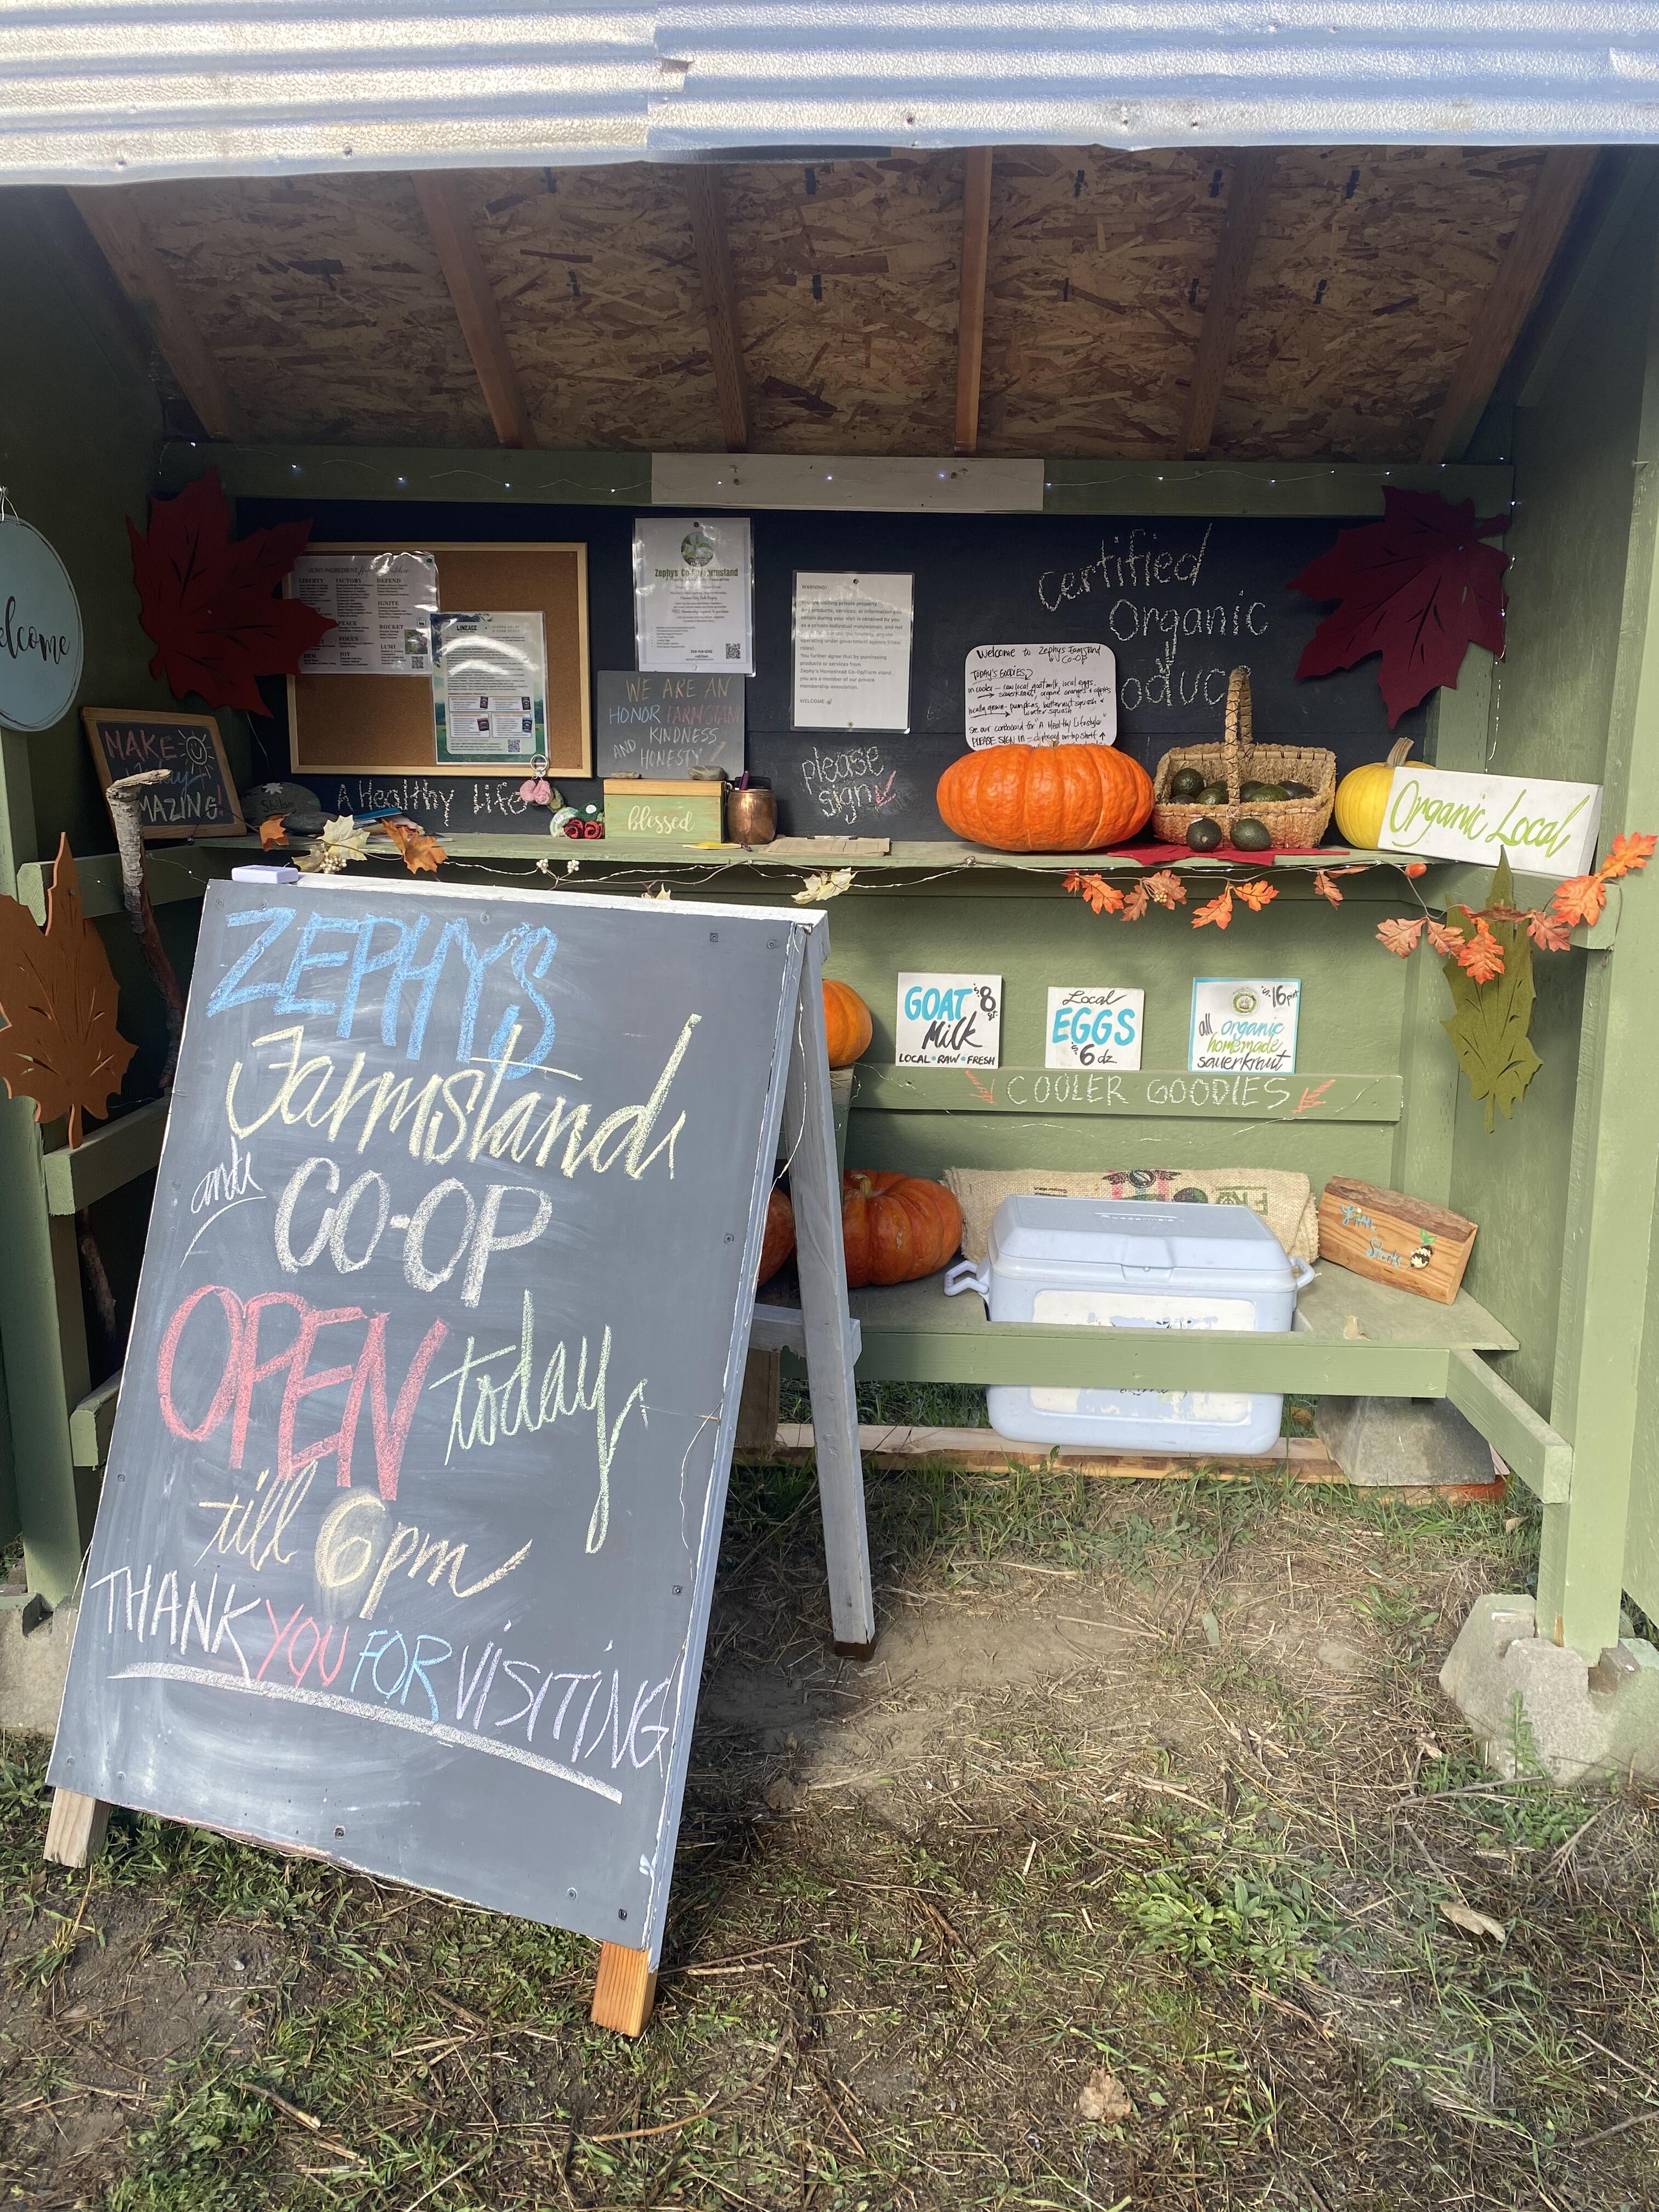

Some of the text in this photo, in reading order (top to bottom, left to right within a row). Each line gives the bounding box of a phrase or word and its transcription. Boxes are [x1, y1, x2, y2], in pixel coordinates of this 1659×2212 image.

[654, 568, 678, 577] Zephys
[0, 596, 70, 664] elcome
[977, 646, 1031, 658] Welcome to
[627, 676, 731, 702] WE ARE AN
[976, 684, 993, 692] cooler
[1031, 678, 1047, 693] goat
[1063, 676, 1076, 687] local
[1064, 689, 1086, 698] oranges
[610, 704, 661, 724] HONOR
[969, 704, 986, 715] locally
[1075, 698, 1097, 709] squash
[1048, 706, 1072, 717] squash
[650, 726, 719, 744] KINDNESS
[1048, 718, 1071, 733] Healthy
[105, 730, 177, 763] MAKE
[614, 739, 636, 759] AND
[972, 736, 997, 747] PLEASE
[998, 735, 1015, 744] SIGN
[641, 747, 703, 770] HONESTY
[802, 746, 884, 795] please
[139, 785, 224, 822] MAZING!
[338, 783, 353, 811] A
[359, 779, 455, 827] Healthy
[628, 805, 695, 834] blessed
[1390, 780, 1590, 858] Organic Local
[905, 986, 973, 1021] GOAT
[1062, 990, 1127, 1006] Local
[1286, 990, 1300, 1006] pint
[922, 1011, 983, 1051] Milk
[1052, 1007, 1136, 1046] EGGS
[1199, 1013, 1285, 1041] all organic
[1207, 1032, 1284, 1054] homemade
[899, 1053, 996, 1065] LOCAL RAW FRESH
[1007, 1073, 1290, 1109] COOLER GOODIES
[275, 1156, 553, 1310] CO-OP
[157, 1284, 649, 1555] OPEN today
[193, 1462, 319, 1572] till
[90, 1564, 262, 1684] THANK
[255, 1598, 351, 1689] YOU
[350, 1627, 454, 1723] FOR
